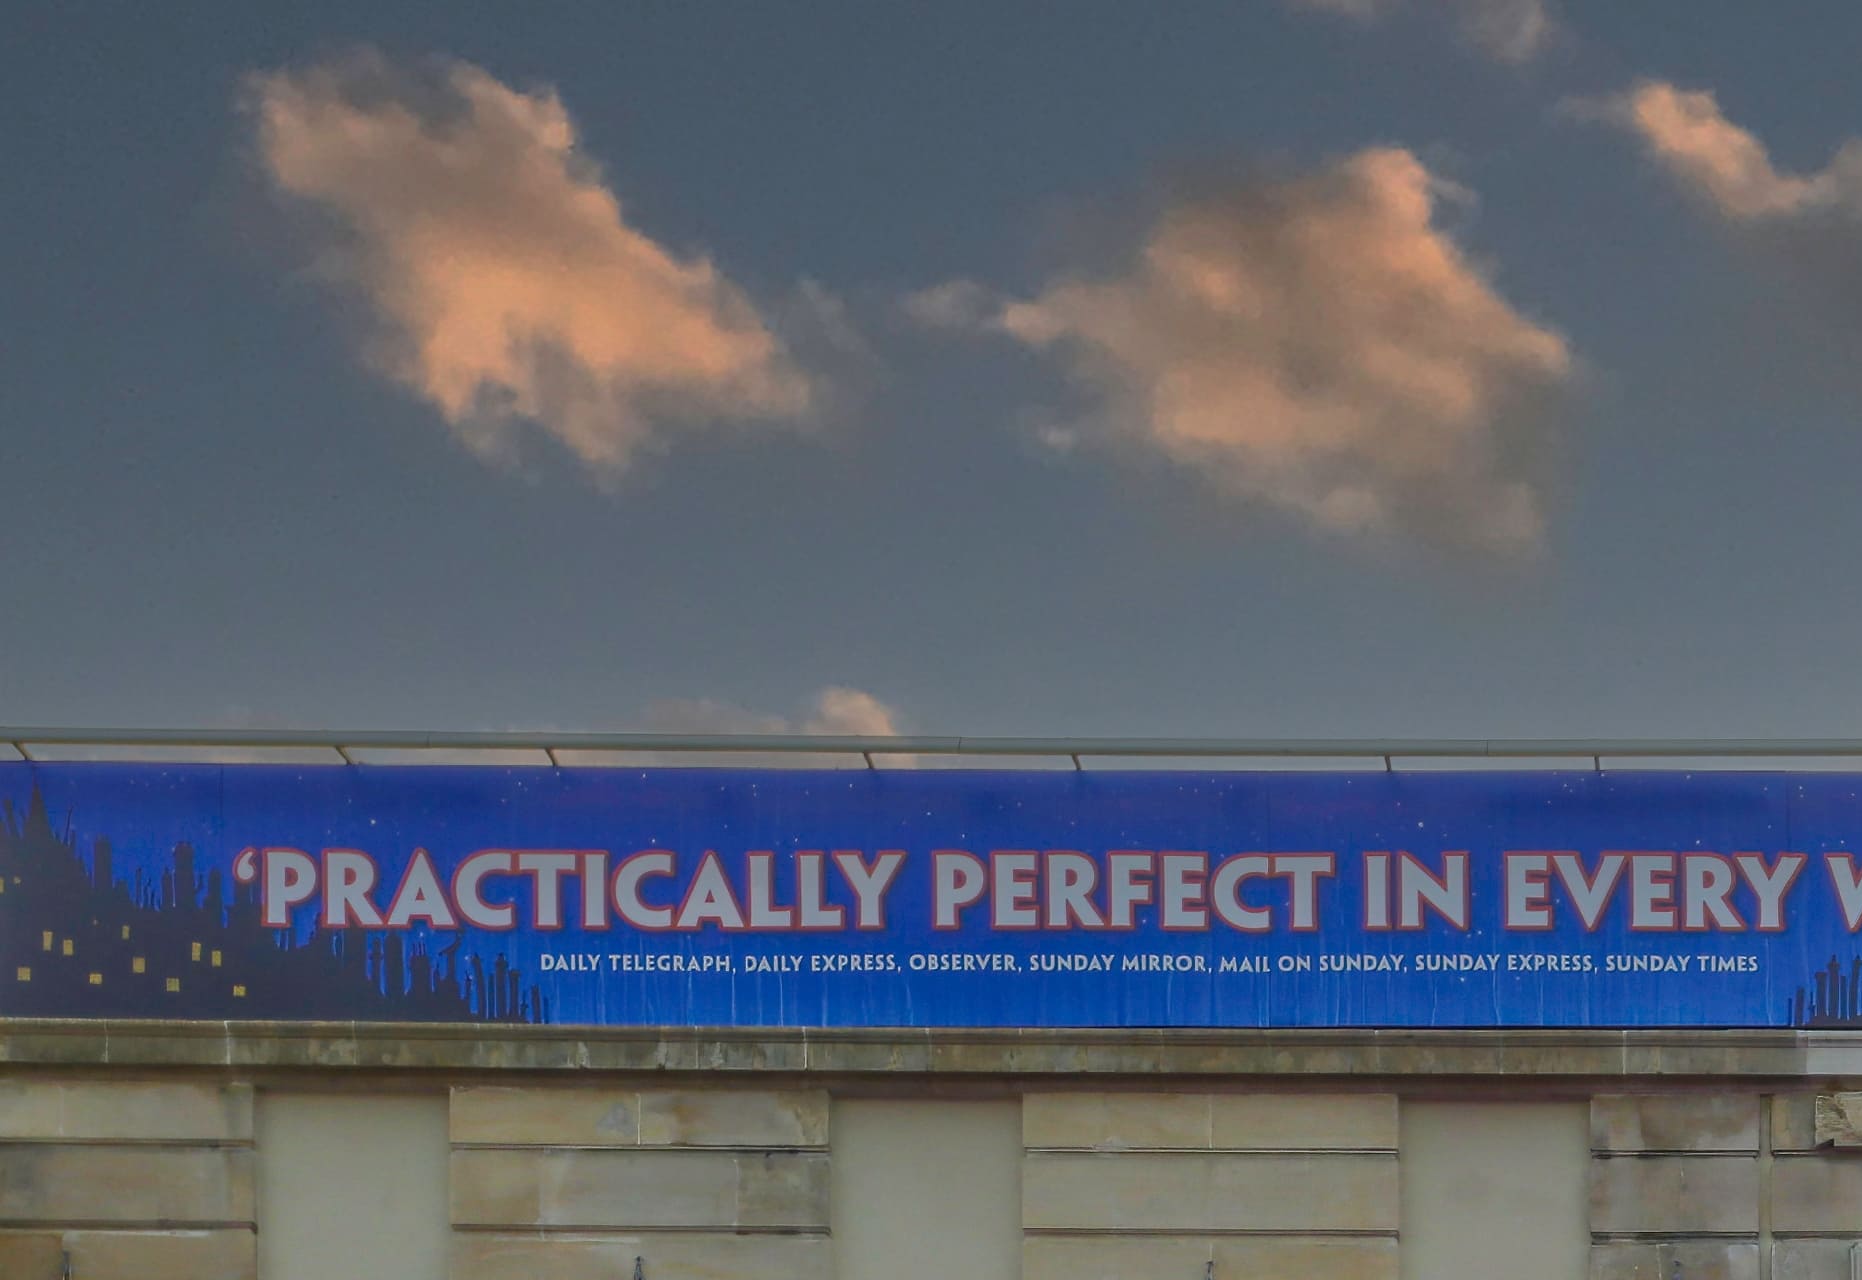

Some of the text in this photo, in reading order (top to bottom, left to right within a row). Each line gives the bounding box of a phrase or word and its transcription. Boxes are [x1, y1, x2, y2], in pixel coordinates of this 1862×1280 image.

[932, 849, 1336, 930] PERFECT
[1363, 850, 1470, 930] IN
[1504, 850, 1807, 931] EVERY
[540, 954, 1758, 976] DAILY TELEGRAPH, DAILY EXPRESS, OBSERVER, SUNDAY MIRROR, MAIL ON SUNDAY, SUNDAY EXPRESS, SUNDAY TIMES
